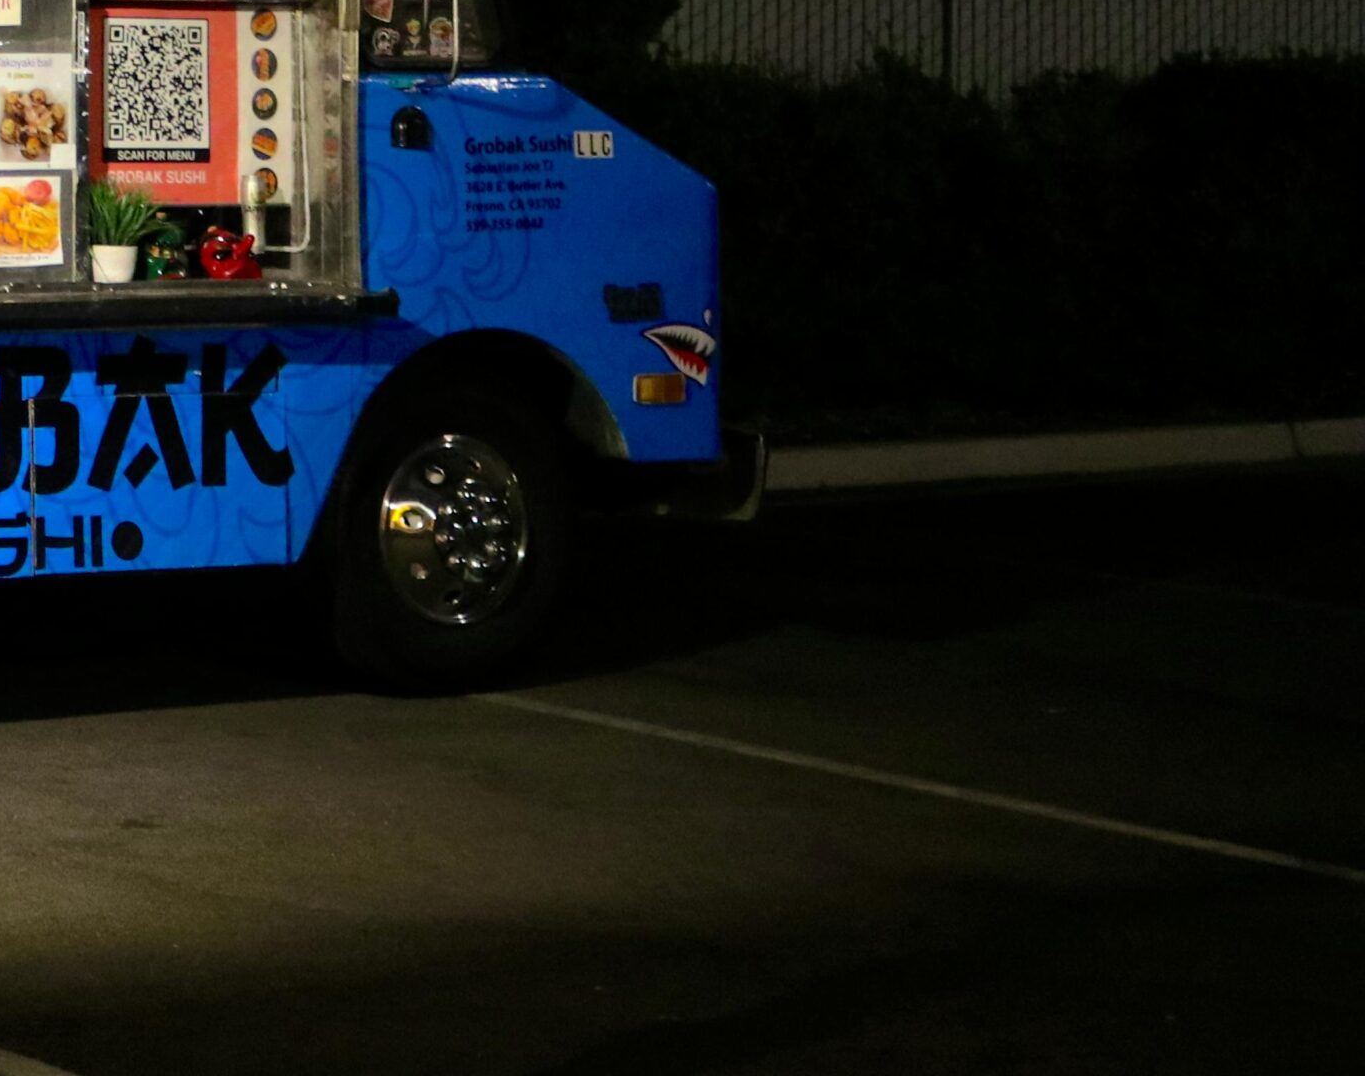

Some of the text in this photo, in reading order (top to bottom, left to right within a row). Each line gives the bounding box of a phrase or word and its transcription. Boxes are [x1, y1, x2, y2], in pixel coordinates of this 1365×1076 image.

[465, 133, 611, 156] Grobak Sushi LLC
[117, 150, 196, 162] SCAN FOR MENU
[108, 170, 207, 184] GROBAK SUSHI
[509, 198, 526, 212] CA
